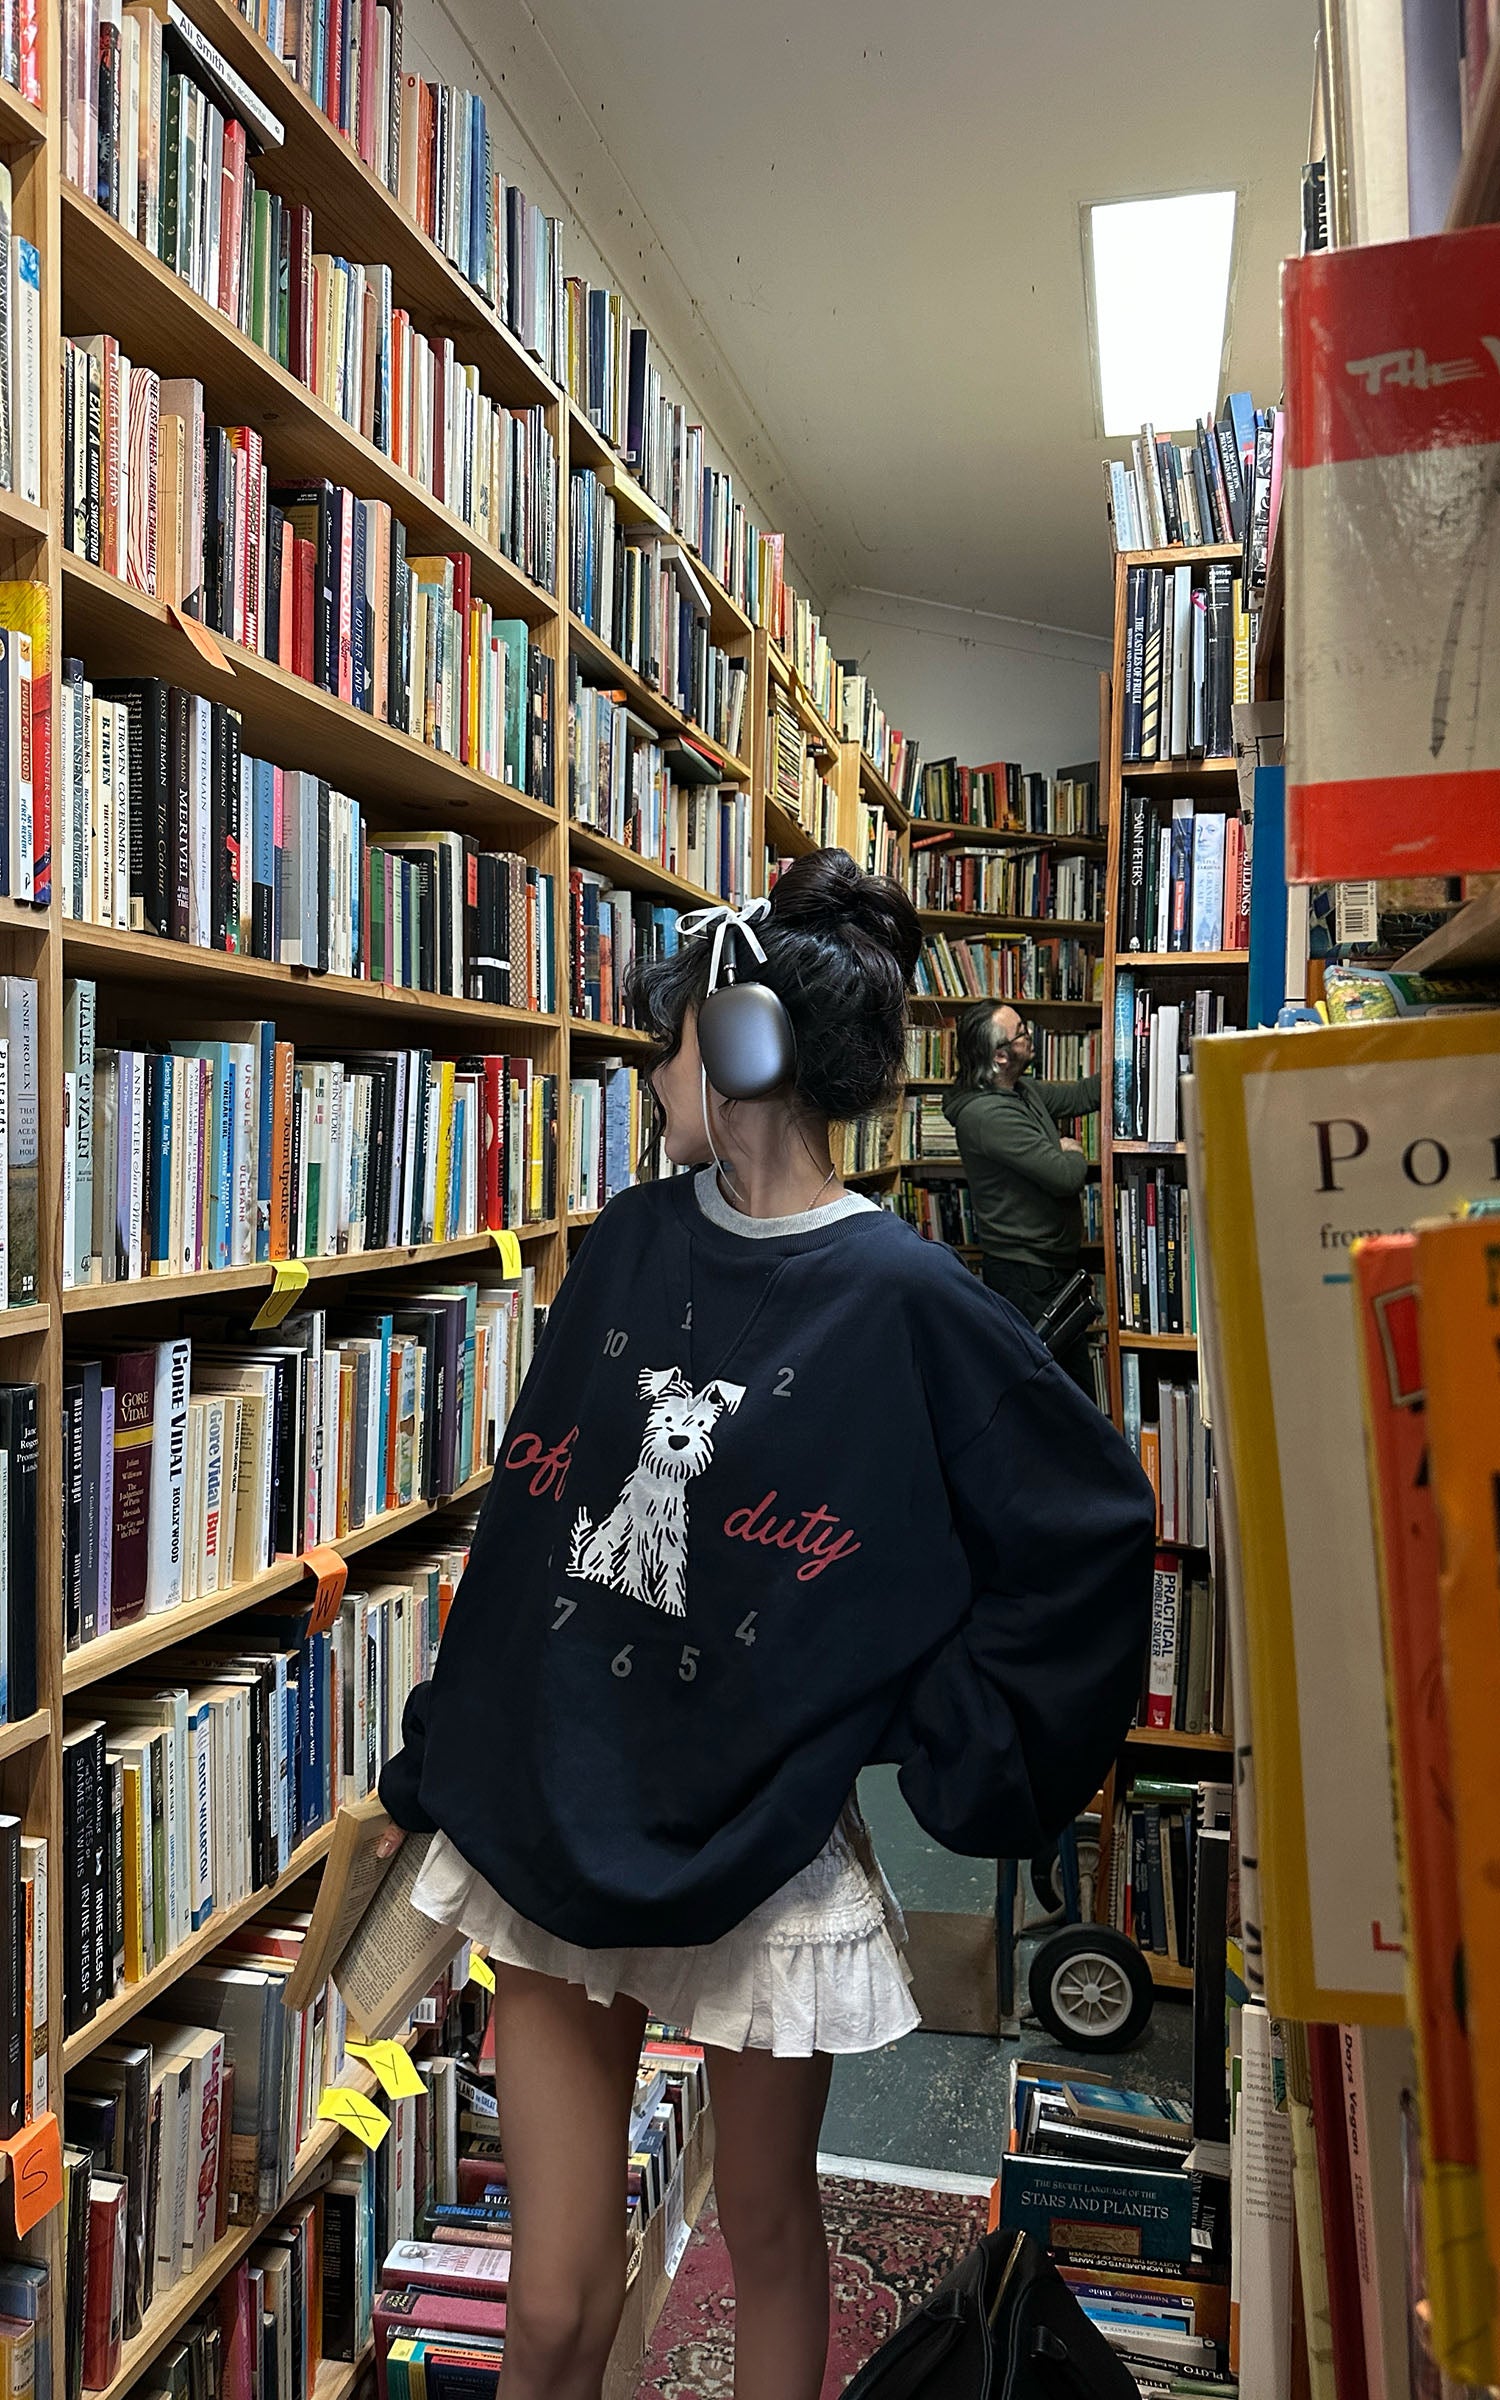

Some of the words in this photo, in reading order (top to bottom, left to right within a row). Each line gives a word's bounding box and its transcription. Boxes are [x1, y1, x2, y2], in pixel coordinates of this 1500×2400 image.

[180, 16, 193, 39] Ali
[195, 34, 225, 75] Smith
[112, 148, 120, 186] Double
[112, 188, 120, 216] Blind
[26, 290, 36, 316] BEN
[26, 318, 36, 352] OKRI
[1346, 347, 1486, 397] THE
[148, 380, 158, 403] THE
[88, 392, 100, 432] EXIT
[88, 431, 100, 444] A
[148, 404, 158, 467] LISTENERS
[1220, 432, 1232, 471] PRINCIPLES
[88, 449, 100, 499] ANTHONY
[1226, 471, 1233, 481] OF
[1229, 480, 1237, 503] HOME
[88, 502, 100, 562] SWOFFORD
[355, 608, 364, 659] MOTHER
[1132, 616, 1144, 632] THE
[1132, 633, 1144, 666] CASTLES
[1236, 638, 1250, 661] TAJ
[355, 660, 364, 693] LAND
[1132, 667, 1144, 678] OF
[1132, 678, 1144, 704] FRIULI
[21, 682, 30, 722] PURITY
[159, 690, 168, 722] ROSE
[180, 696, 188, 728] ROSE
[220, 718, 228, 749] ROSE
[21, 742, 30, 782] BLOOD
[159, 727, 168, 788] TREMAIN
[180, 732, 188, 784] TREMAIN
[220, 753, 228, 808] TREMAIN
[44, 794, 51, 811] OF
[118, 782, 128, 878] GOVERNMENT
[178, 788, 190, 882] MERIVEL
[1131, 812, 1145, 846] SAINT
[1131, 847, 1145, 886] PETER'S
[1240, 850, 1252, 916] BUILDINGS
[1205, 872, 1213, 915] GRANDER
[22, 990, 30, 1036] ANNIE
[22, 1038, 30, 1090] PROULX
[132, 1064, 141, 1106] ANNE
[243, 1064, 252, 1136] UNQUIET
[282, 1051, 293, 1116] Couples
[330, 1070, 341, 1101] JOHN
[132, 1112, 141, 1156] TYLER
[279, 1117, 292, 1160] John
[330, 1104, 341, 1144] UPDIKE
[239, 1164, 248, 1223] ULLMANN
[279, 1162, 292, 1224] Updike
[1168, 1271, 1176, 1294] Theory
[602, 1329, 628, 1358] 10
[172, 1344, 190, 1410] GORE
[773, 1366, 796, 1398] 2
[72, 1398, 84, 1423] Miss
[120, 1404, 150, 1423] VIDAL
[121, 1391, 149, 1408] GORE
[234, 1404, 242, 1420] TWO
[170, 1413, 187, 1482] VIDAL
[208, 1410, 223, 1456] Gore
[234, 1420, 242, 1450] SISTERS
[72, 1474, 84, 1504] Angel
[104, 1450, 114, 1500] VICKERS
[208, 1456, 223, 1509] Vidal
[170, 1486, 182, 1564] HOLLYWOOD
[206, 1510, 220, 1557] Burr
[723, 1490, 865, 1582] duty
[549, 1594, 578, 1632] 7
[1151, 1571, 1164, 1619] PROBLEM
[734, 1609, 759, 1648] 4
[1162, 1573, 1178, 1656] PRACTICAL
[1151, 1620, 1164, 1656] SOLVER
[610, 1643, 634, 1679] 6
[677, 1645, 701, 1683] 5
[308, 1670, 317, 1697] Works
[308, 1700, 317, 1709] of
[308, 1712, 317, 1738] Oscar
[308, 1740, 317, 1766] Wilde
[76, 1760, 85, 1819] SIAMESE
[84, 1774, 93, 1805] SEX
[114, 1772, 123, 1790] THE
[198, 1752, 208, 1800] EDITH
[84, 1809, 93, 1847] LIVES
[114, 1792, 123, 1830] CUTTING
[76, 1822, 85, 1878] TWINS
[114, 1832, 123, 1859] ROOM
[198, 1802, 208, 1884] WHARTON
[114, 1868, 123, 1899] LOUISE
[80, 1883, 90, 1938] IRVINE
[94, 1888, 105, 1933] IRVINE
[114, 1900, 123, 1933] WELSH
[80, 1944, 90, 1994] WELSH
[94, 1934, 105, 1983] WELSH
[375, 2053, 399, 2086] Y
[1344, 2032, 1356, 2084] Days
[333, 2097, 382, 2138] X
[1348, 2090, 1360, 2156] Vegan
[21, 2147, 50, 2201] S
[1033, 2178, 1051, 2188] THE
[1052, 2180, 1082, 2191] SECRET
[1084, 2184, 1127, 2196] LANGUAGE
[1128, 2188, 1140, 2197] OF
[1140, 2190, 1157, 2199] THE
[434, 2204, 486, 2216] SUPERGRASSES
[487, 2208, 494, 2216] &
[1020, 2191, 1066, 2208] STARS
[1069, 2196, 1100, 2210] AND
[1103, 2200, 1170, 2220] PLANETS
[1069, 2251, 1100, 2260] FOREVER
[1069, 2255, 1092, 2265] MARS
[1094, 2258, 1108, 2267] OF
[1110, 2260, 1162, 2273] MONUMENTS
[1131, 2257, 1145, 2265] THE
[1164, 2265, 1182, 2275] THE
[1088, 2287, 1112, 2297] Bible
[1113, 2290, 1169, 2304] Numerology
[1182, 2366, 1224, 2380] PLUTO
